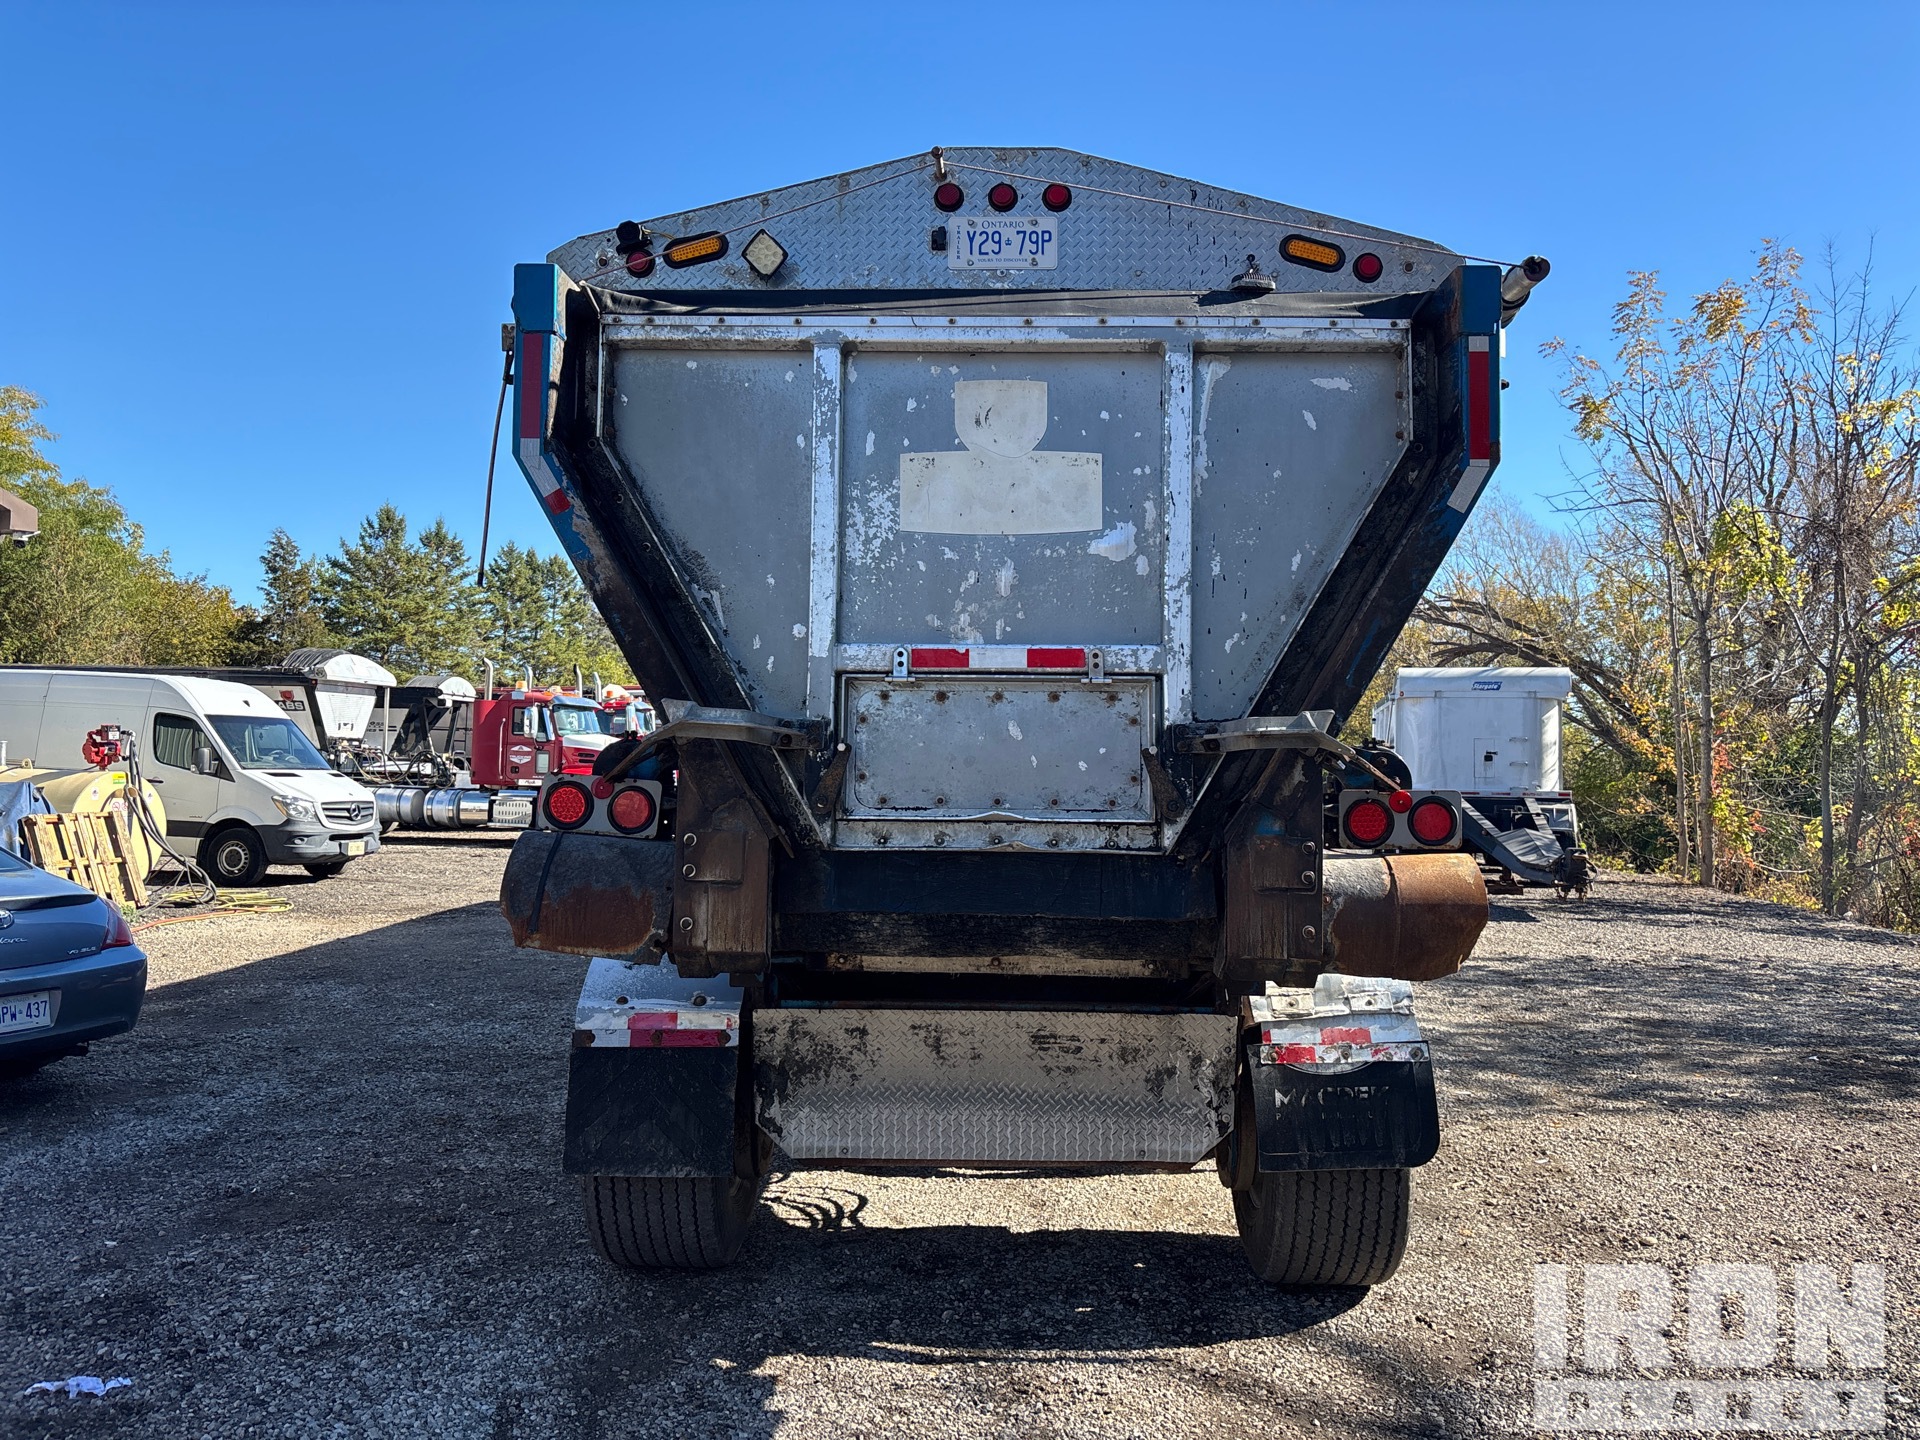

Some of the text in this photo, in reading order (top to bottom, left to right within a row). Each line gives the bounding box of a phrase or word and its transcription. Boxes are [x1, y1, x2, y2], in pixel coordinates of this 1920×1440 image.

[981, 220, 1025, 229] ONTARIO
[966, 230, 1052, 256] Y29 79P
[25, 999, 48, 1019] 437
